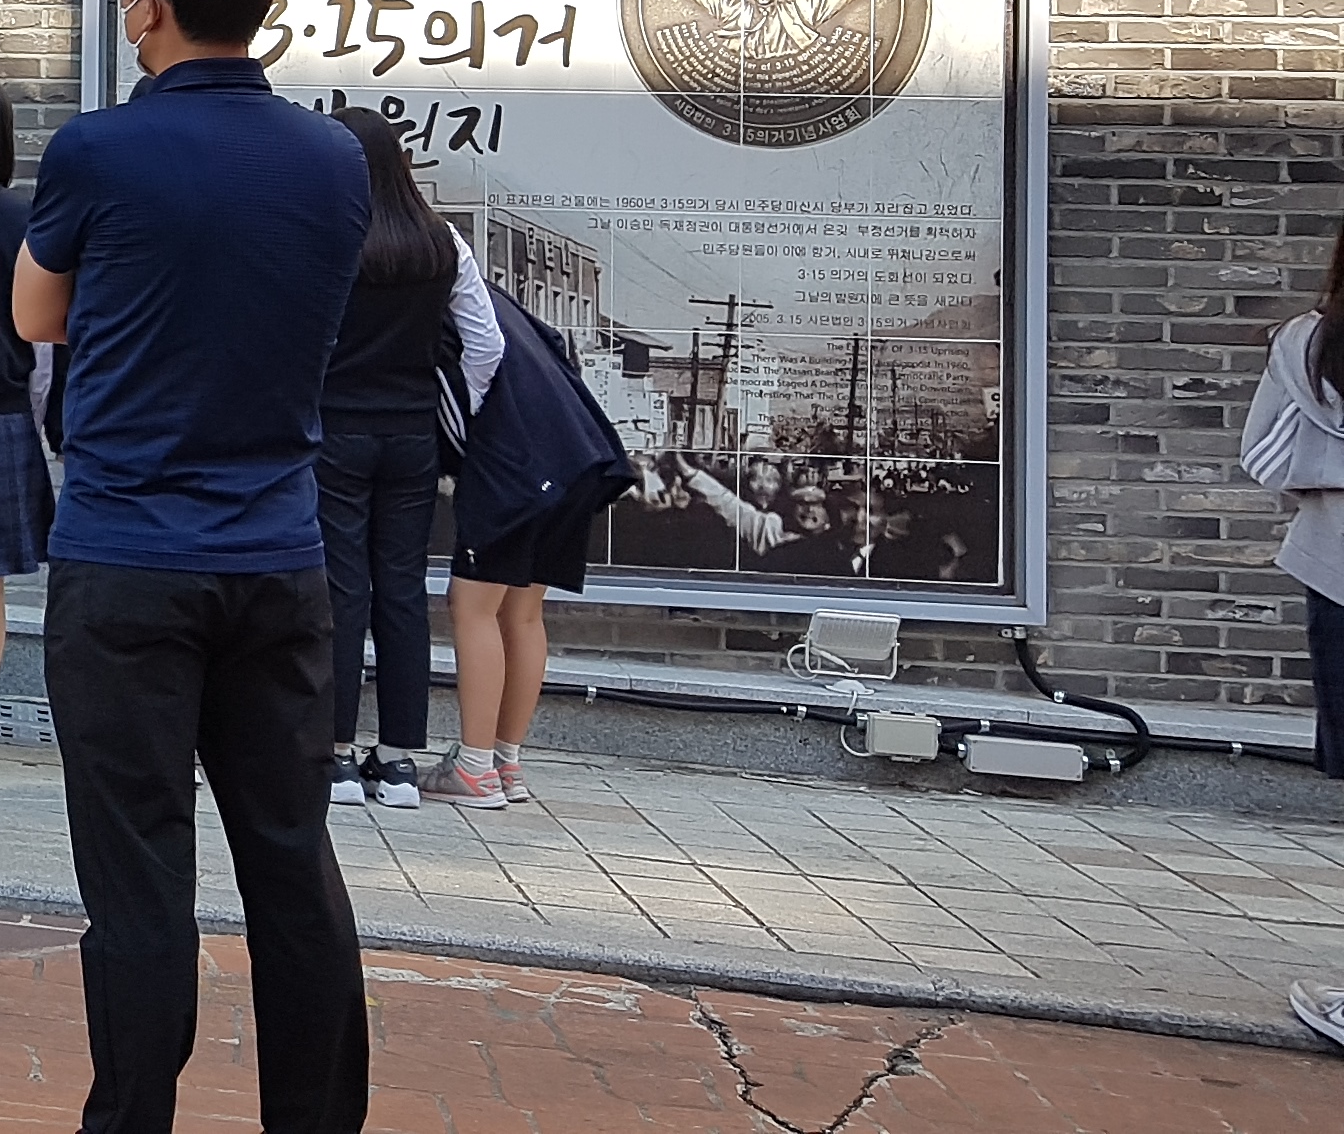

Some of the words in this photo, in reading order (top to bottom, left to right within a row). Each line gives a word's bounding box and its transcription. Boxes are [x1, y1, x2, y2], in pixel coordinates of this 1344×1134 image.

[292, 88, 503, 170] 원지
[721, 106, 863, 146] 3·5의거기념사업회
[488, 193, 500, 205] 이
[505, 193, 555, 206] 표지판의
[561, 195, 611, 208] 건물에는
[615, 196, 657, 209] 1960년
[660, 197, 710, 210] 3·15의거
[715, 198, 739, 211] 당시
[616, 218, 654, 232] 이승만
[857, 316, 907, 328] 315의거
